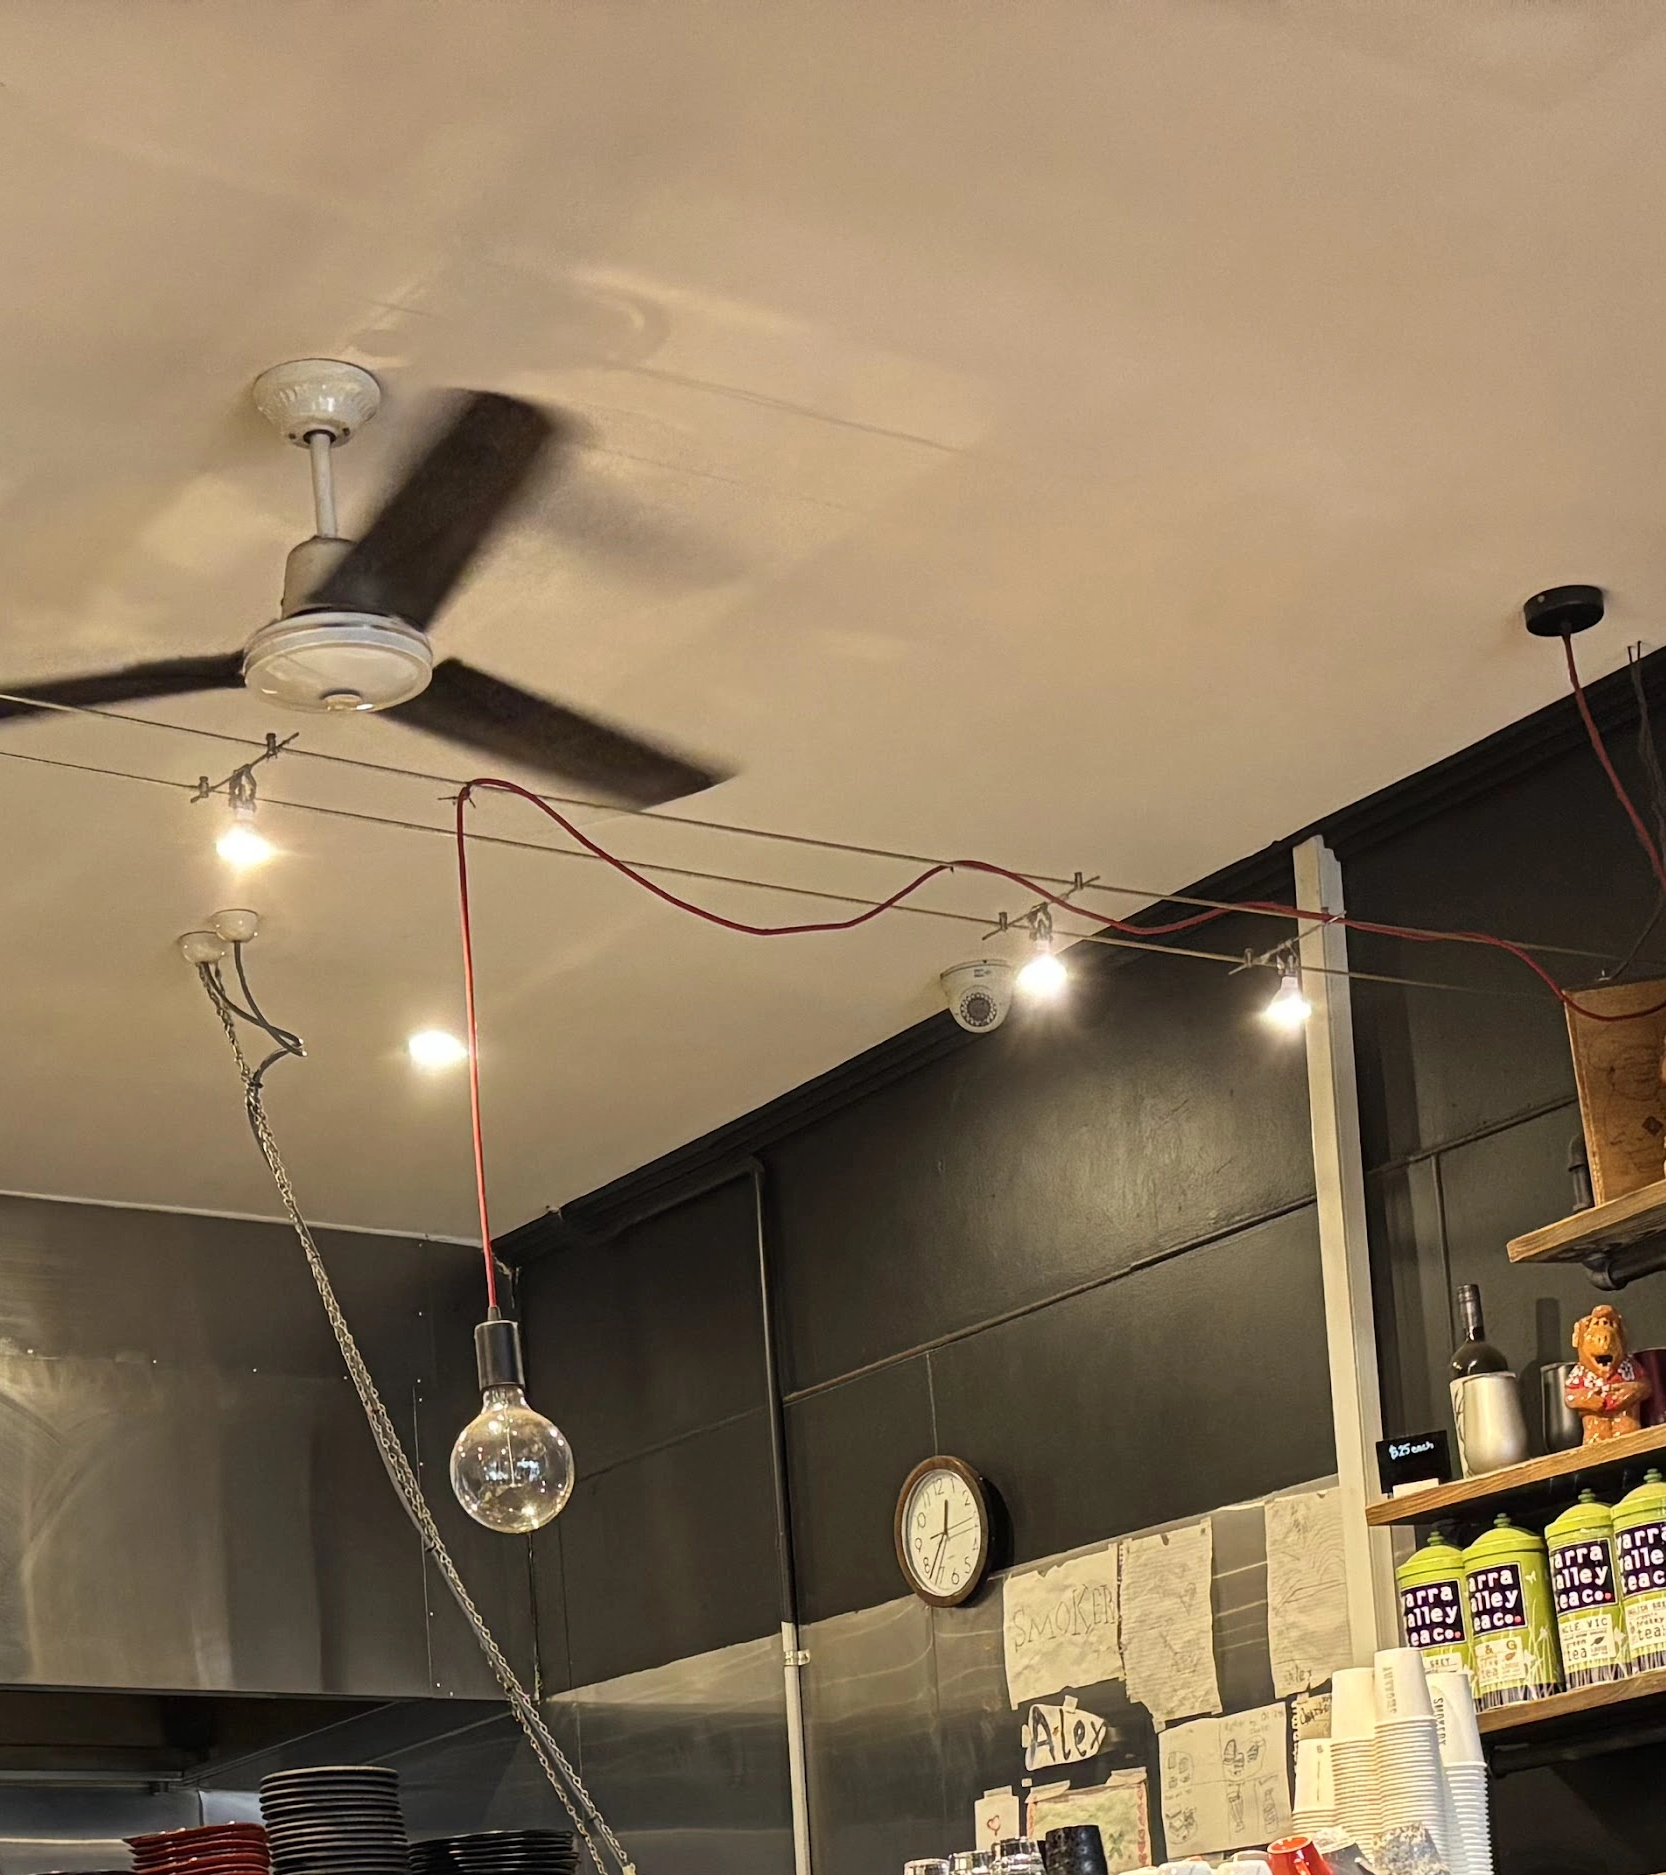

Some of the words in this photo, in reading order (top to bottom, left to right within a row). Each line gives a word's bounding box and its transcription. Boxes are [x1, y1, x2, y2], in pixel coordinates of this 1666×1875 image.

[1551, 1545, 1604, 1569] arra
[1467, 1569, 1514, 1593] arra
[1554, 1565, 1608, 1590] alley
[1401, 1585, 1454, 1608] arra
[1470, 1589, 1519, 1613] alley
[1013, 1583, 1117, 1653] SMOKER
[1406, 1605, 1458, 1628] alley
[1587, 1617, 1608, 1629] VIC
[1637, 1626, 1662, 1641] tea
[1567, 1648, 1587, 1662] tea
[1032, 1705, 1107, 1763] Alex
